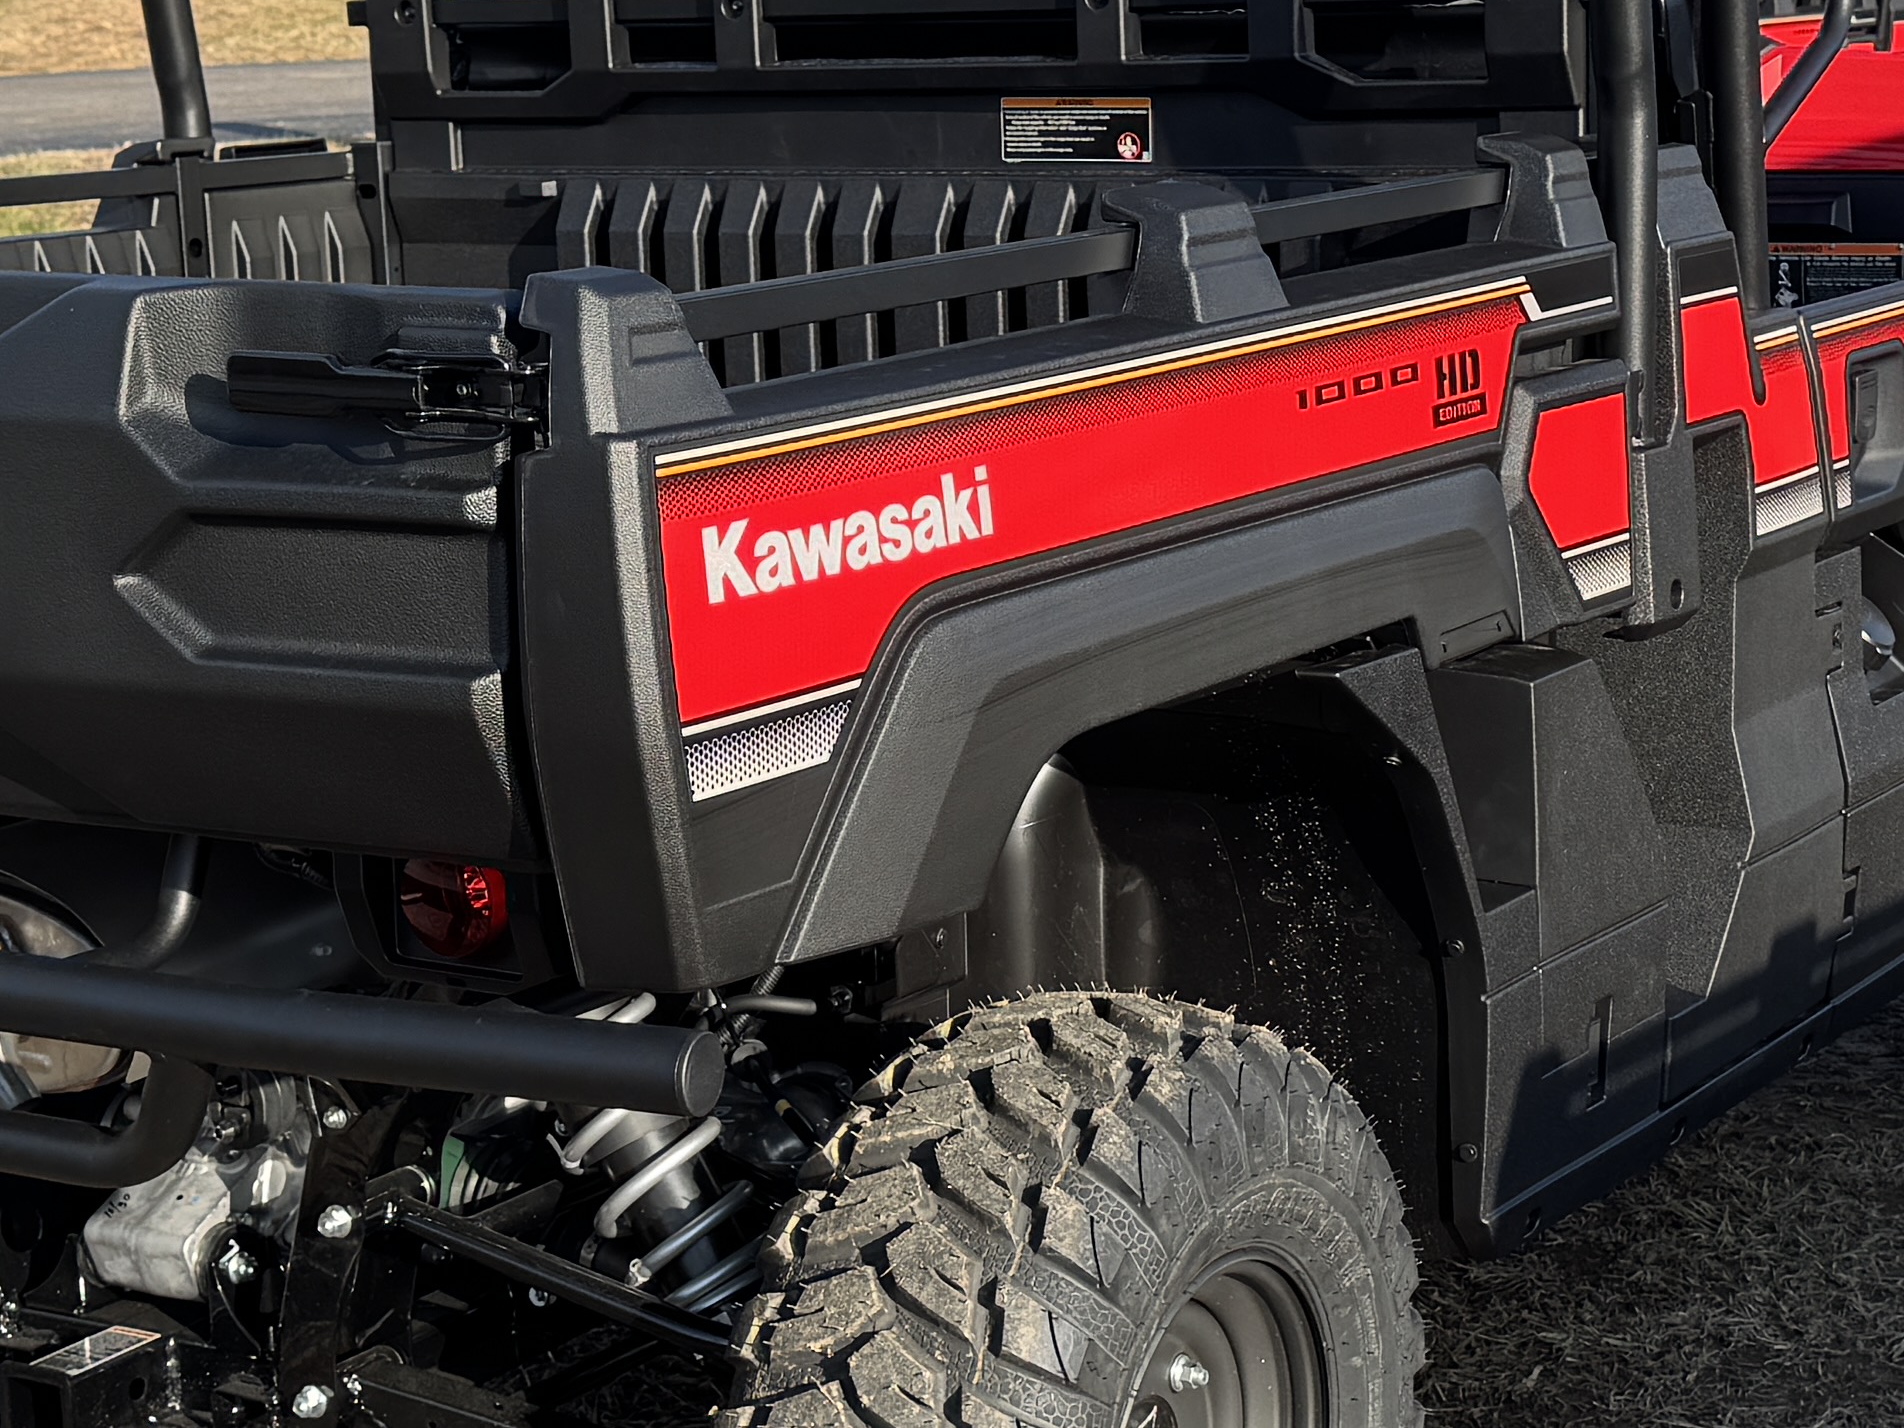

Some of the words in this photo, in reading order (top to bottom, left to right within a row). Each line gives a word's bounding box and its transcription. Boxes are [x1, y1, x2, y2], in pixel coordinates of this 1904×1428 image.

[1296, 361, 1419, 410] 1000
[1434, 348, 1481, 400] HD
[1438, 399, 1482, 421] EDITION
[700, 466, 995, 605] Kawasaki
